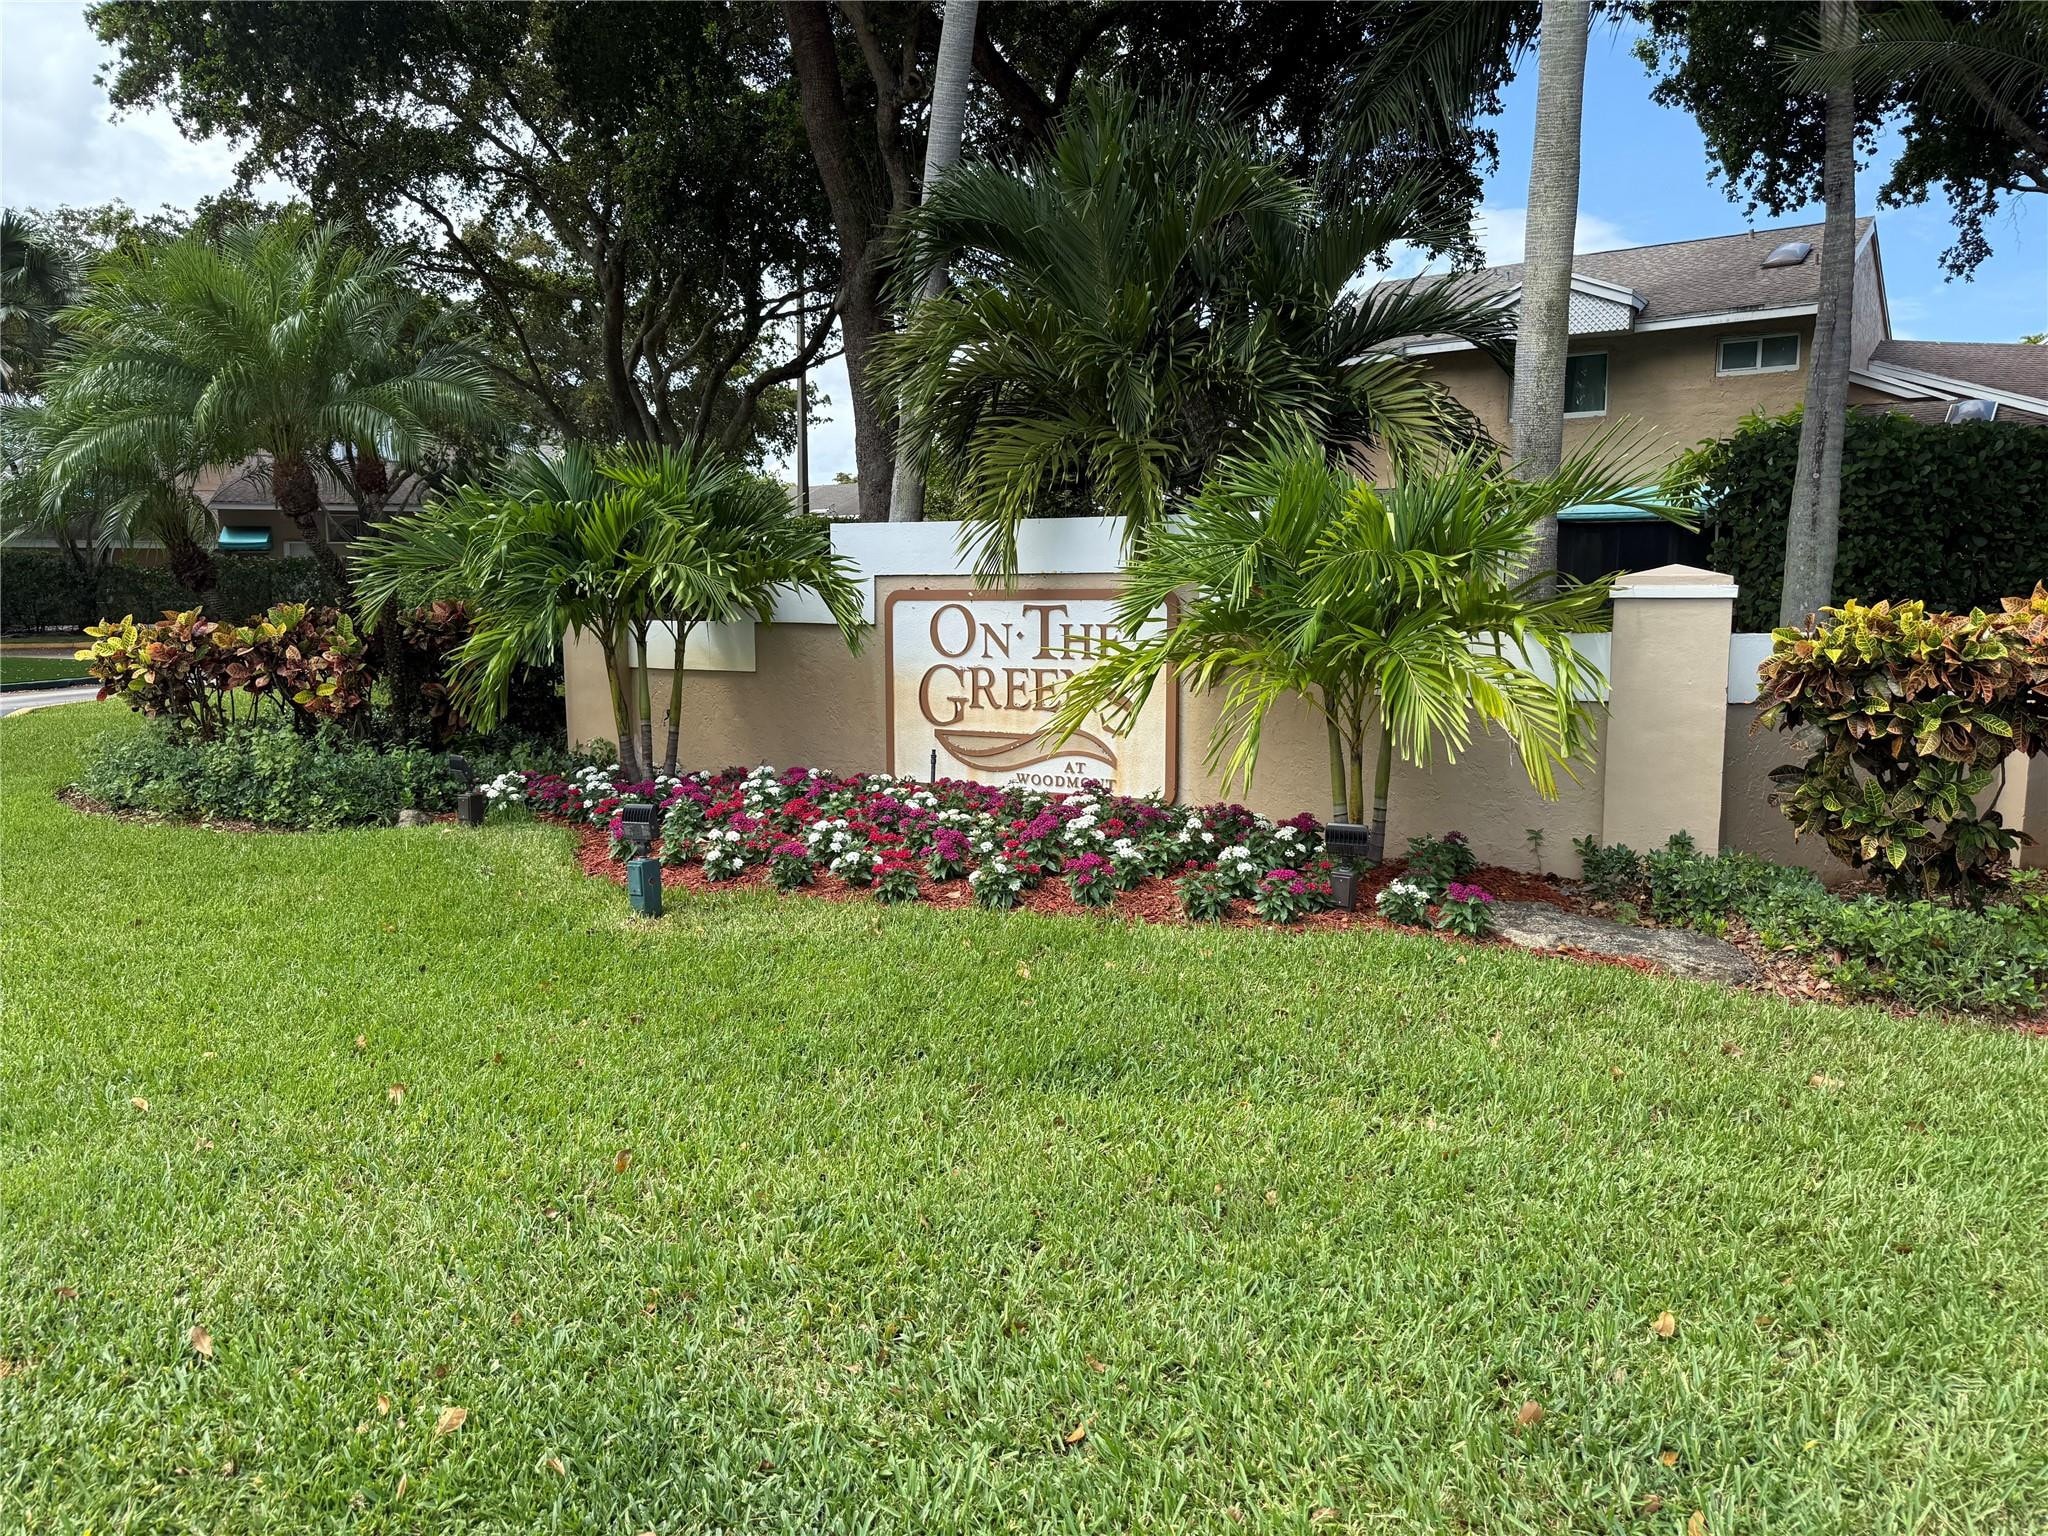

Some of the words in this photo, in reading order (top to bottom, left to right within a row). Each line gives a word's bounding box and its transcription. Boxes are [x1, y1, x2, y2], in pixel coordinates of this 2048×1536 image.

[919, 664, 1136, 736] GREE
[1064, 761, 1086, 774] AT
[1016, 772, 1117, 790] WOODMT
